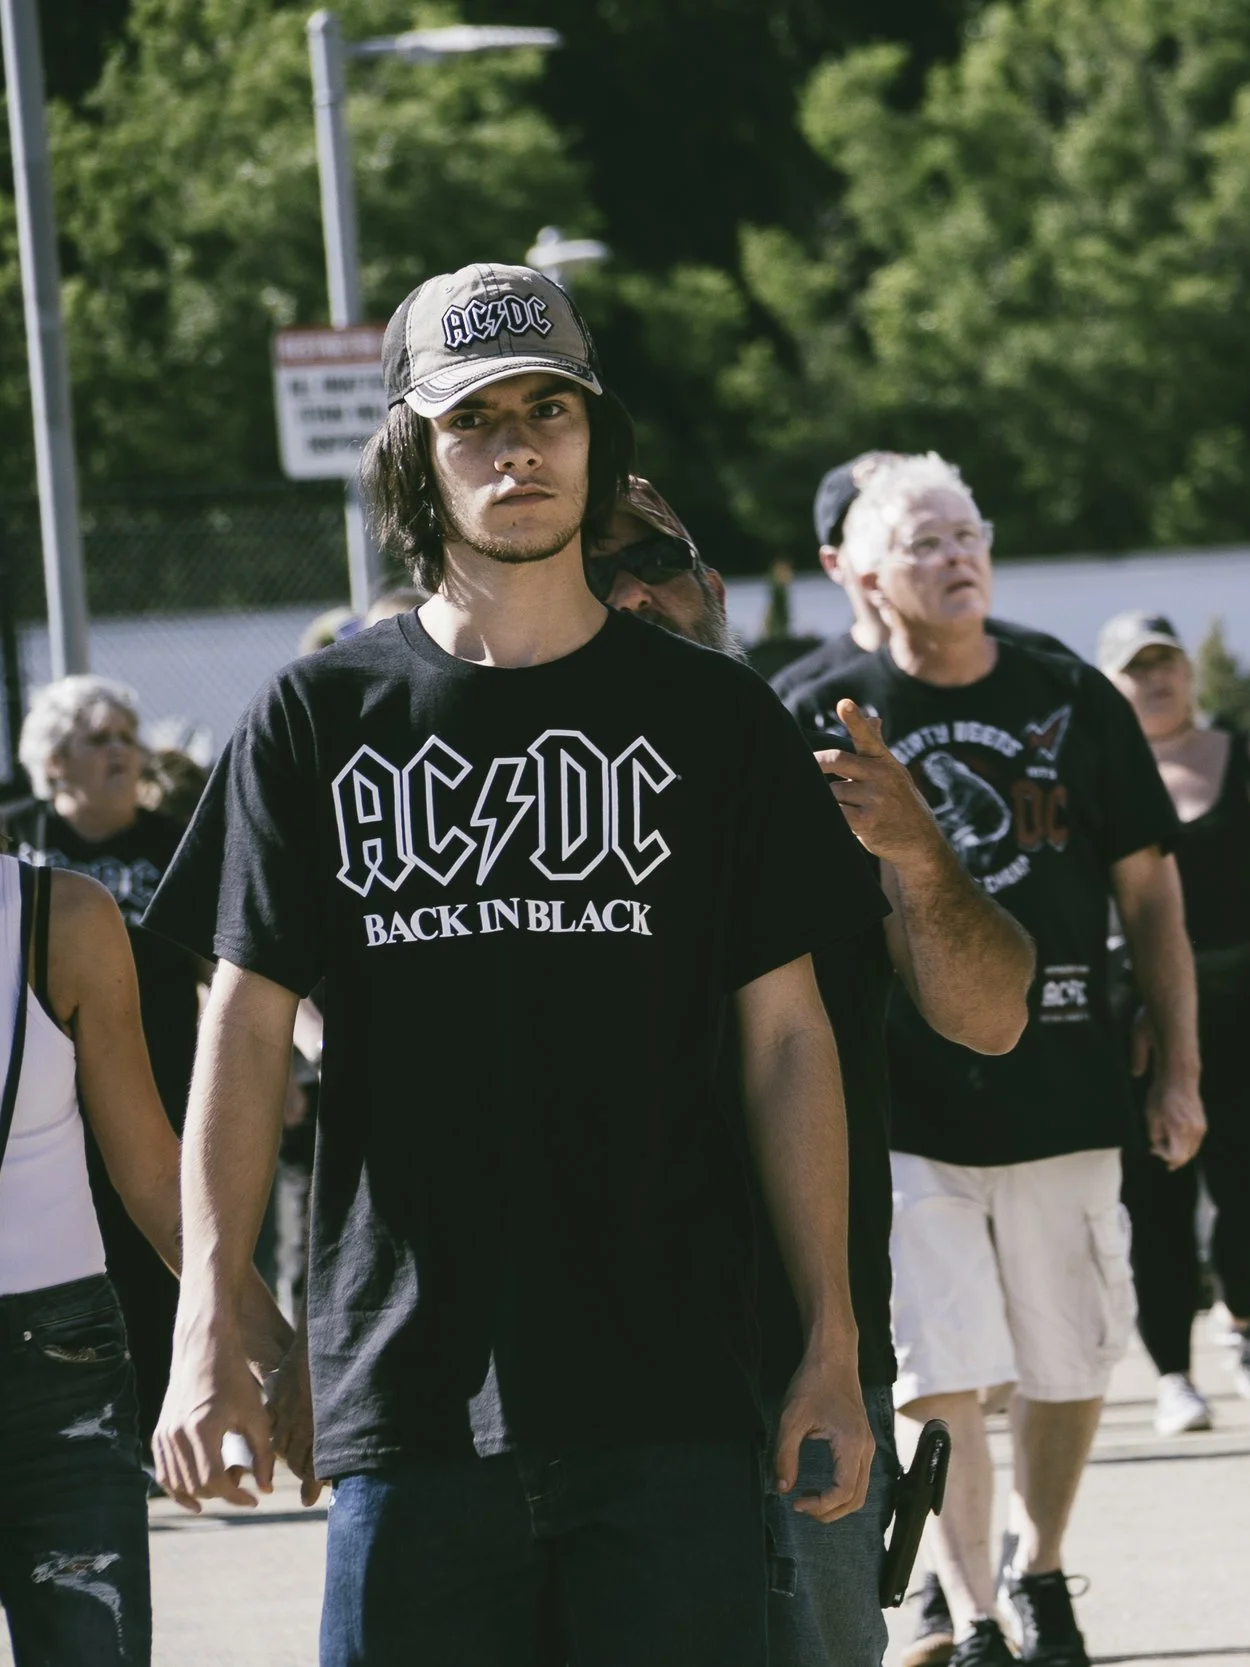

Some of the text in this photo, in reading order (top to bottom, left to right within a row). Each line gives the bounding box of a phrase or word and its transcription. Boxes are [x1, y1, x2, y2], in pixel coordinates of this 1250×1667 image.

[331, 729, 677, 897] AC/DC
[363, 898, 653, 947] BACK IN BLACK
